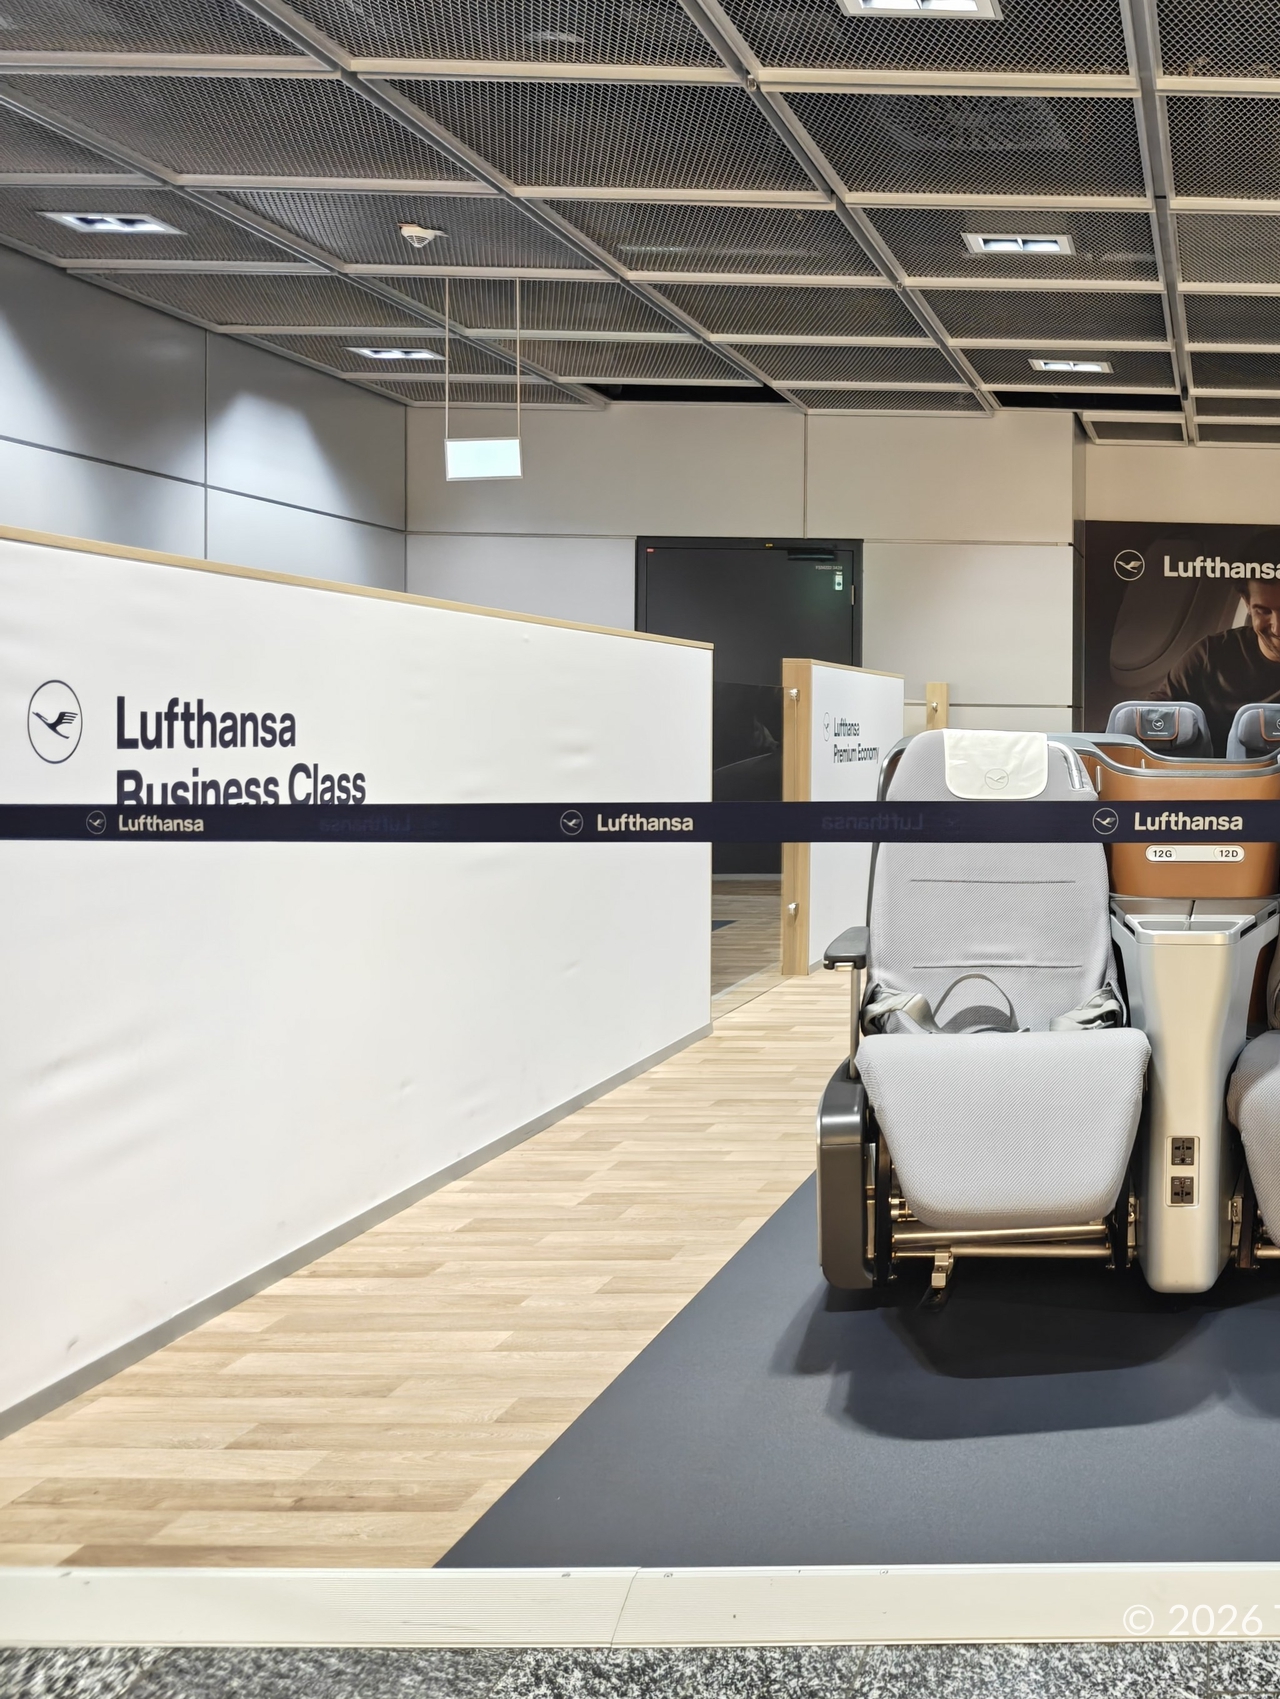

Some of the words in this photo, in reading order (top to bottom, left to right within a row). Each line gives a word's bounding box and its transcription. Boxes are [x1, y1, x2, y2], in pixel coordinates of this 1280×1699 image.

[115, 695, 297, 750] Lufthansa
[833, 717, 860, 738] Lufthansa
[833, 743, 857, 763] Premium
[857, 743, 880, 764] Economy
[288, 762, 367, 805] Class
[118, 814, 205, 832] Lufthansa
[596, 813, 694, 832] Lufthansa
[1133, 812, 1243, 832] Lufthansa
[1152, 849, 1173, 859] 12G
[1218, 849, 1239, 859] 12D
